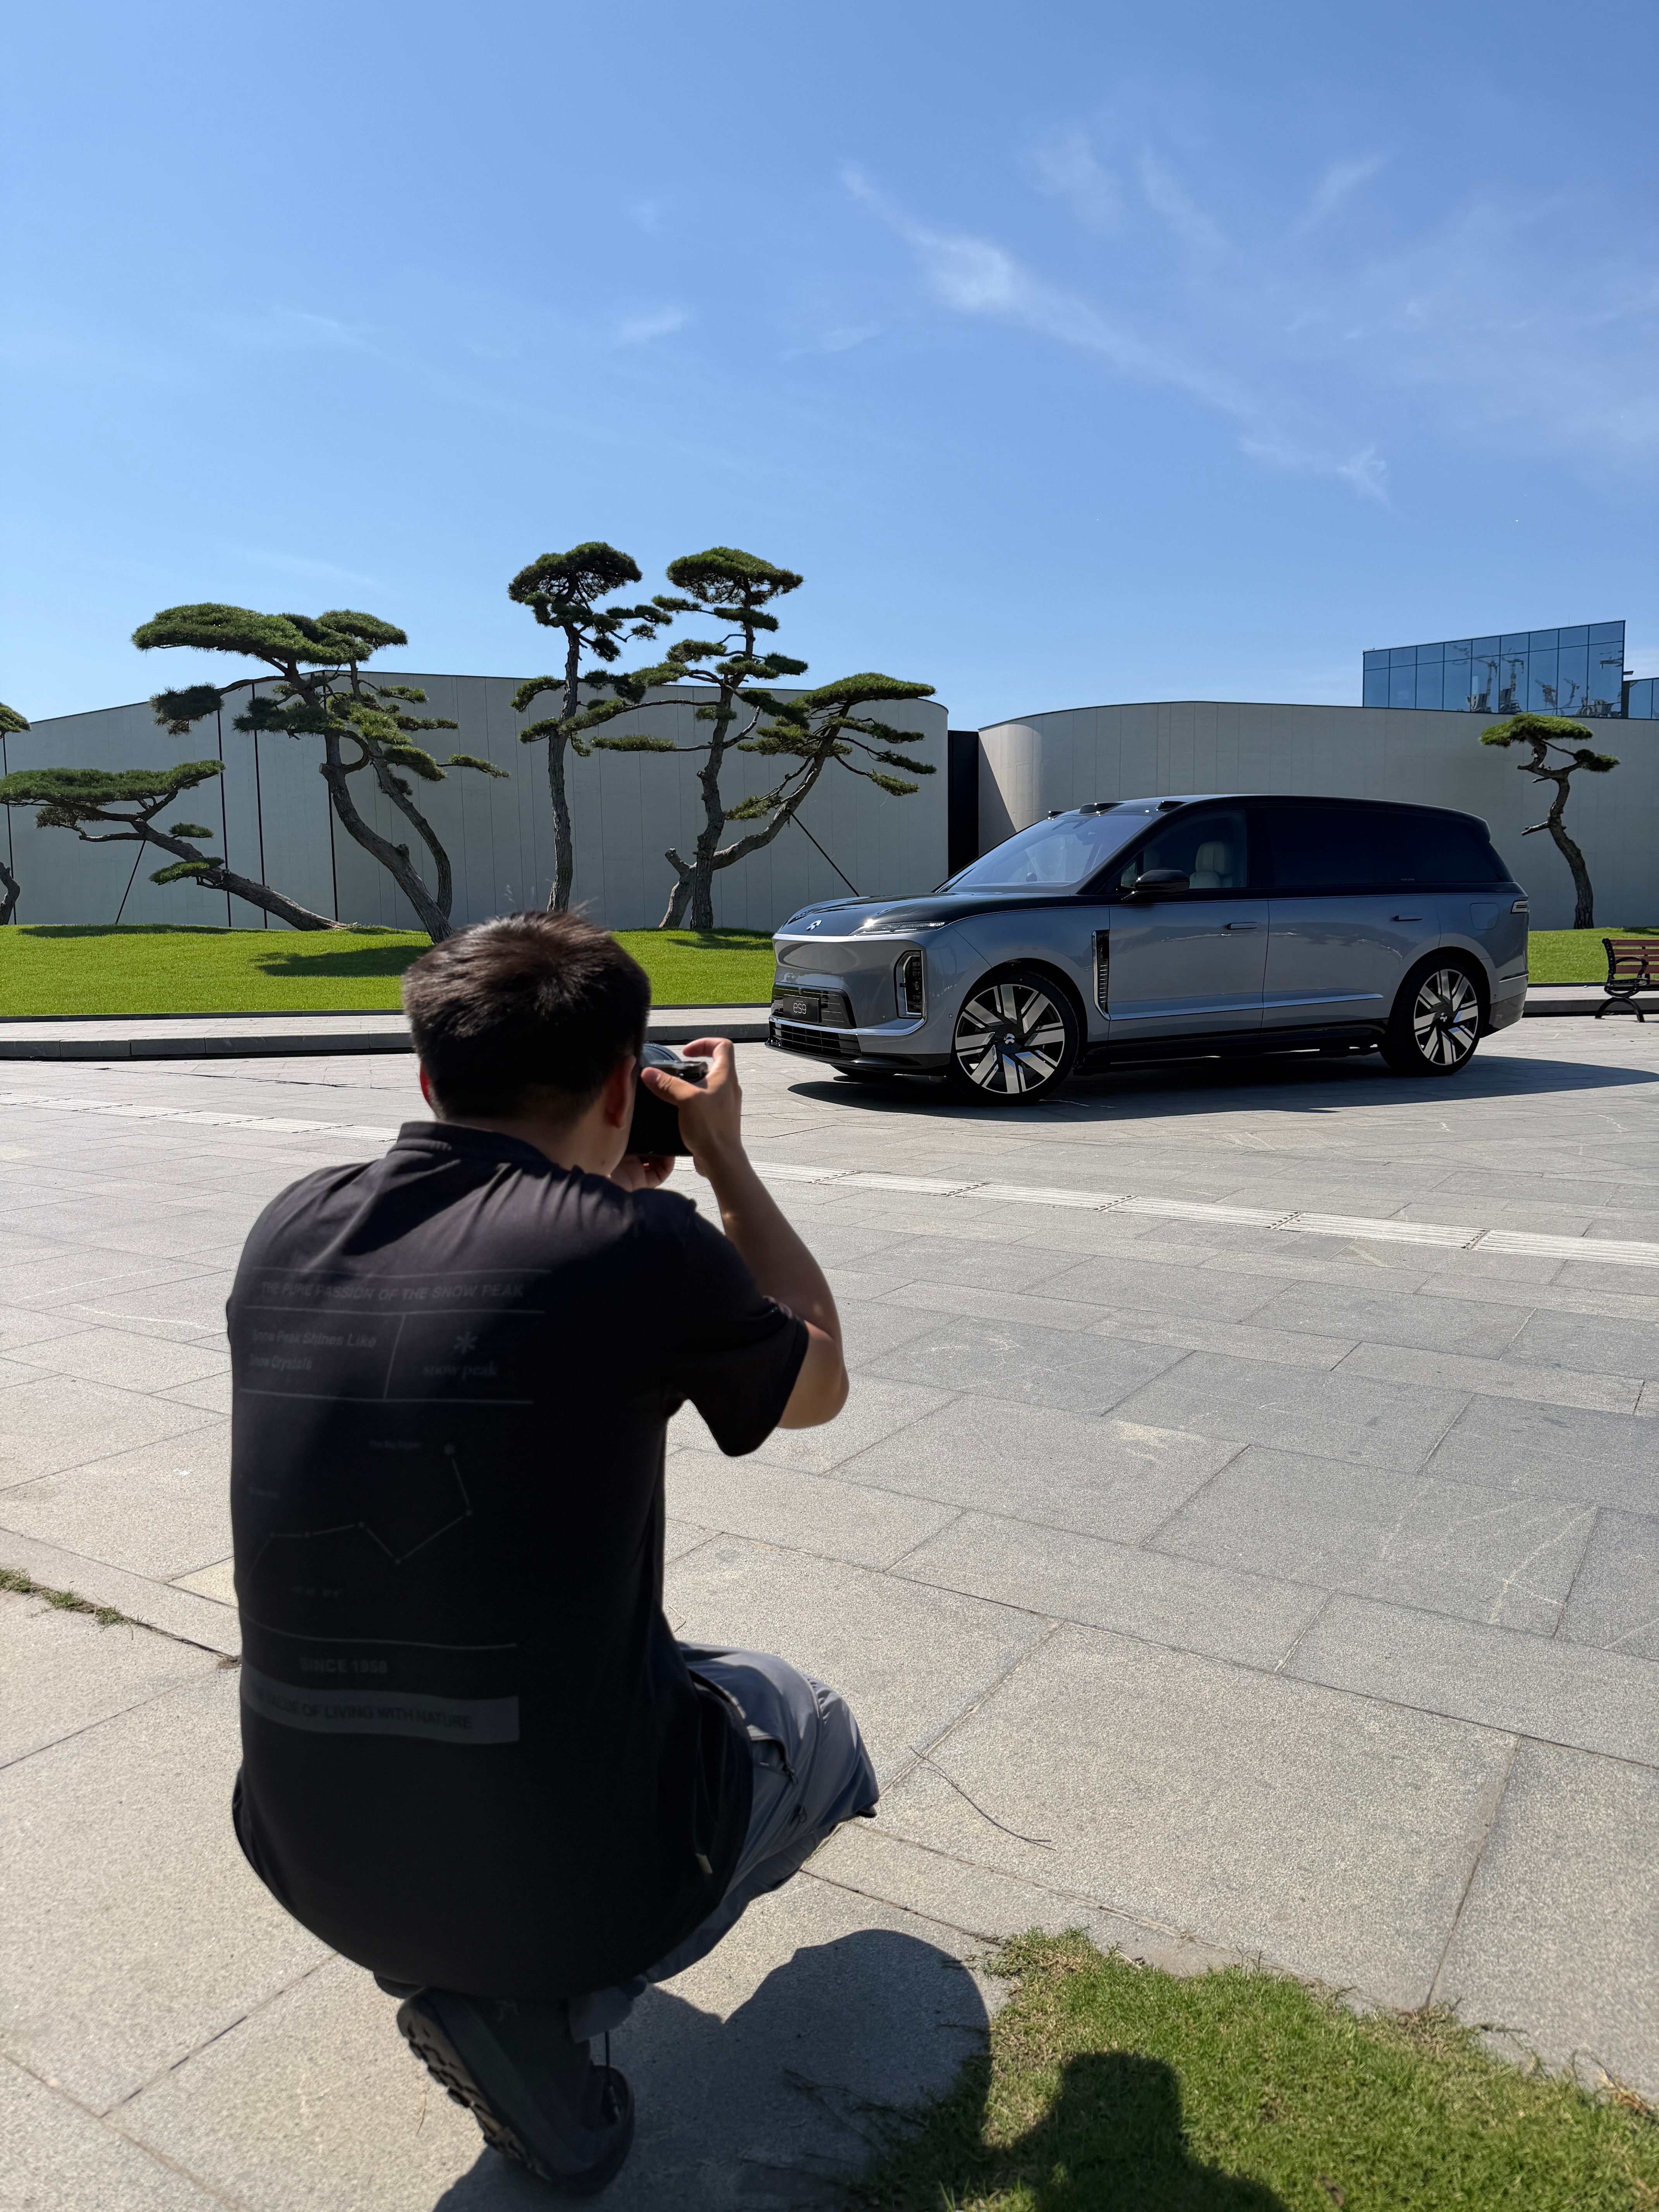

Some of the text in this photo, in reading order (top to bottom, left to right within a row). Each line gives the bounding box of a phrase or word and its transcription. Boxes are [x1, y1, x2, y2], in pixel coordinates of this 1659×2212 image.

[261, 1281, 281, 1294] THE
[316, 1283, 375, 1300] PASSION
[378, 1288, 398, 1301] OF
[402, 1287, 428, 1300] THE
[432, 1285, 478, 1298] SNOW
[481, 1284, 524, 1297] PEAK
[252, 1328, 376, 1348] Snow Peak Shines Like
[271, 1355, 313, 1375] Crystals
[422, 1360, 498, 1381] snow peak
[299, 1656, 348, 1673] SINCE
[301, 1702, 321, 1717] OF
[325, 1705, 374, 1720] LIVING
[376, 1705, 413, 1721] WITH
[416, 1709, 472, 1730] NATURE
